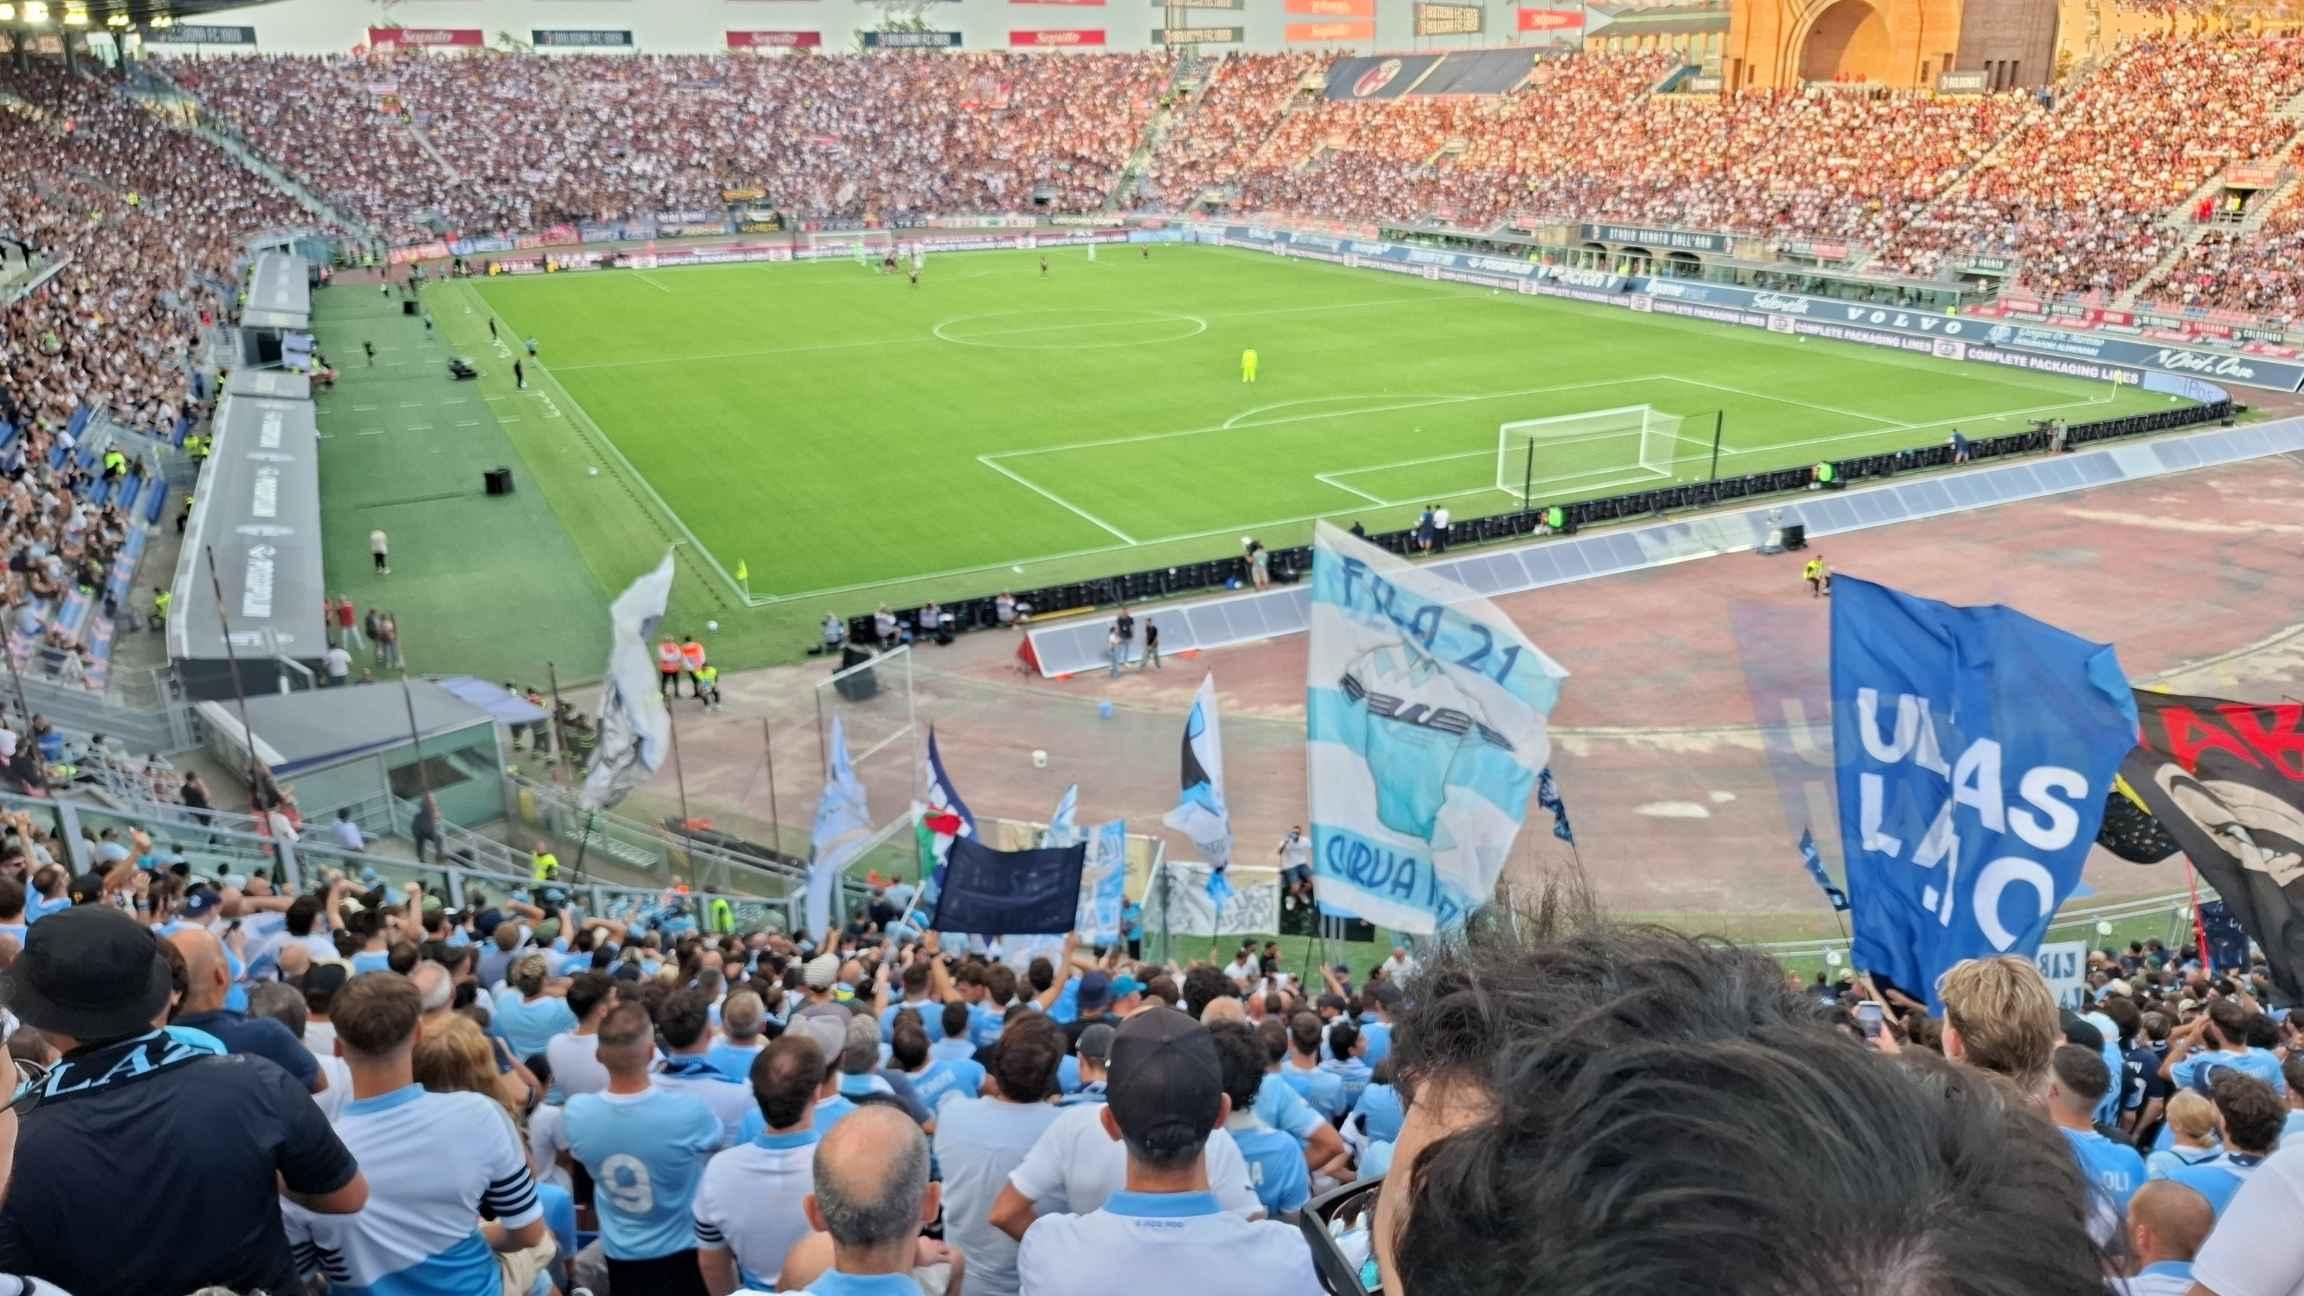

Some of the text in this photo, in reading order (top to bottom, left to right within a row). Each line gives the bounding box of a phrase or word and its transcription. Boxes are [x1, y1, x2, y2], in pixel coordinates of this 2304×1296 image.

[1794, 321, 1932, 353] COMPLETE PACKAGING LINES
[1847, 306, 1963, 335] VOLVO
[1968, 348, 2029, 368] COMPLETE
[2030, 356, 2099, 379] PACKAGING
[1342, 556, 1523, 687] FRA 21
[1326, 833, 1416, 901] CURVA
[601, 1152, 653, 1214] 9
